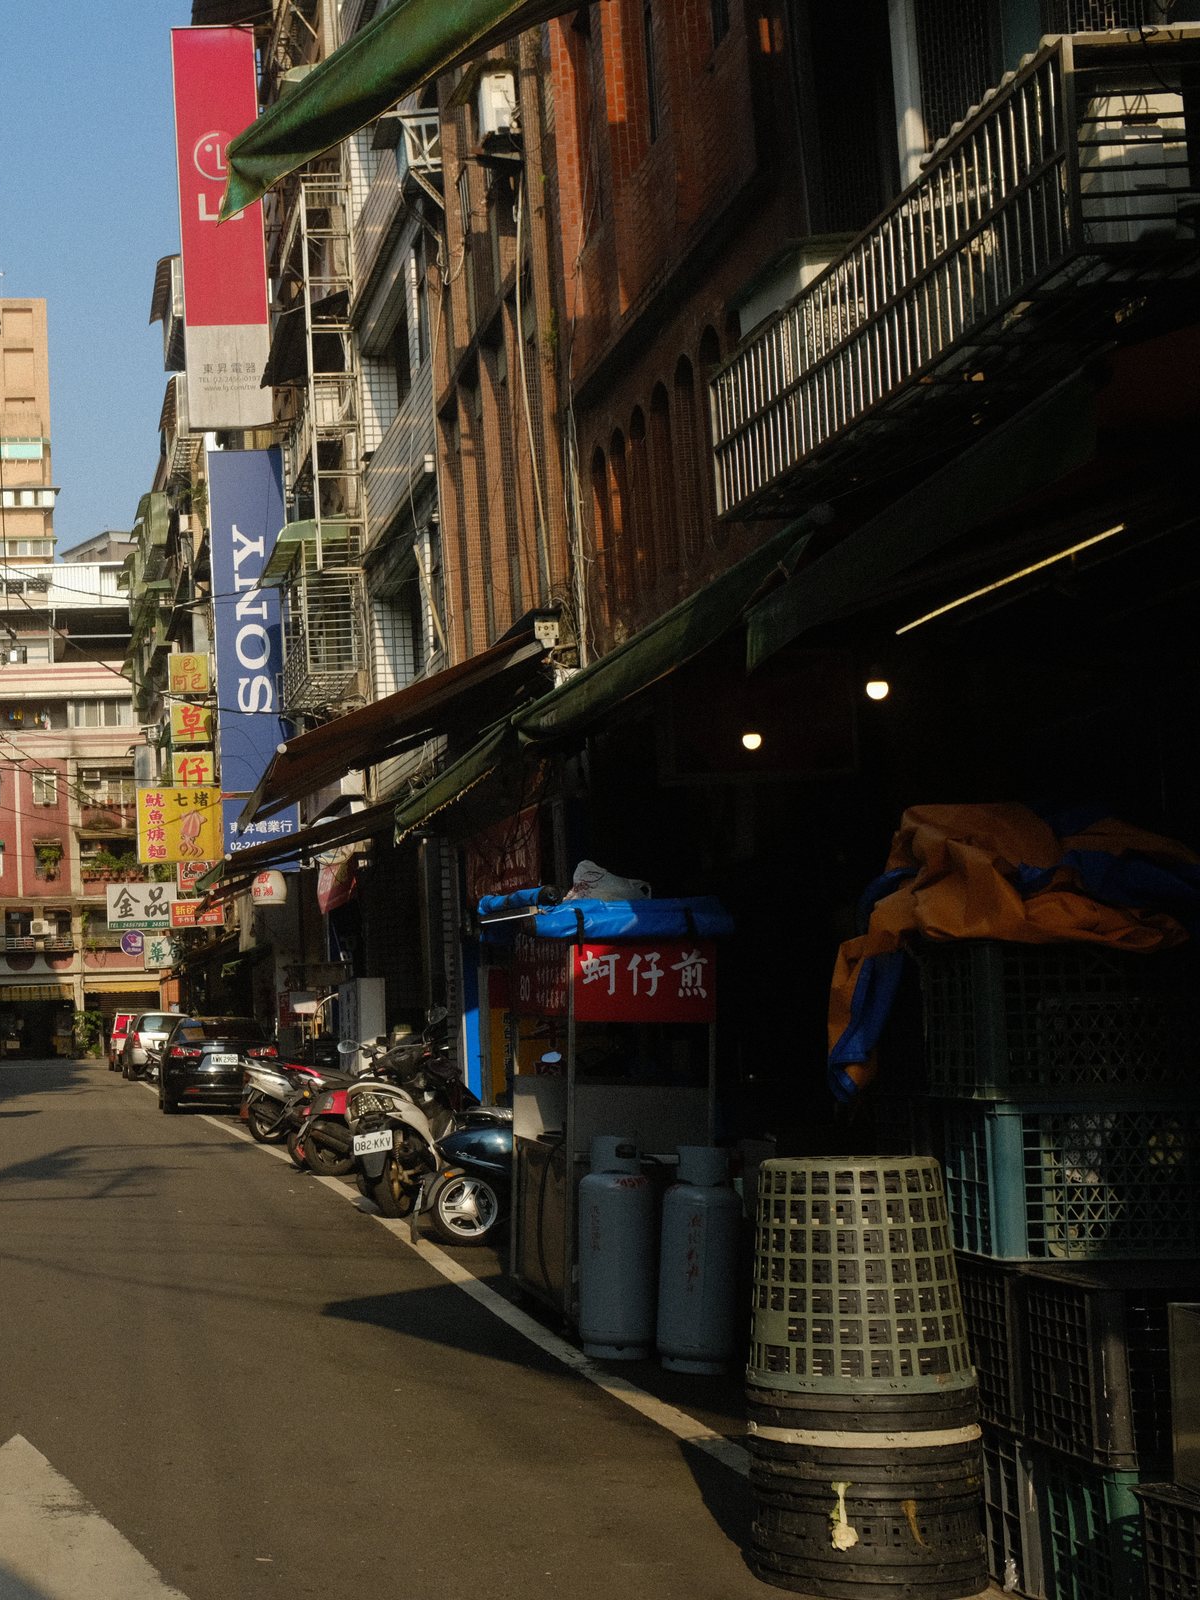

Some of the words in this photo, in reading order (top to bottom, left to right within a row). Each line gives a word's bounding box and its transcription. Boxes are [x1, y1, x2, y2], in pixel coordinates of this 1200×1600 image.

[232, 524, 273, 716] SONY
[173, 791, 209, 808] 七堵
[113, 886, 169, 918] 金品
[580, 949, 708, 999] 蚵仔煎
